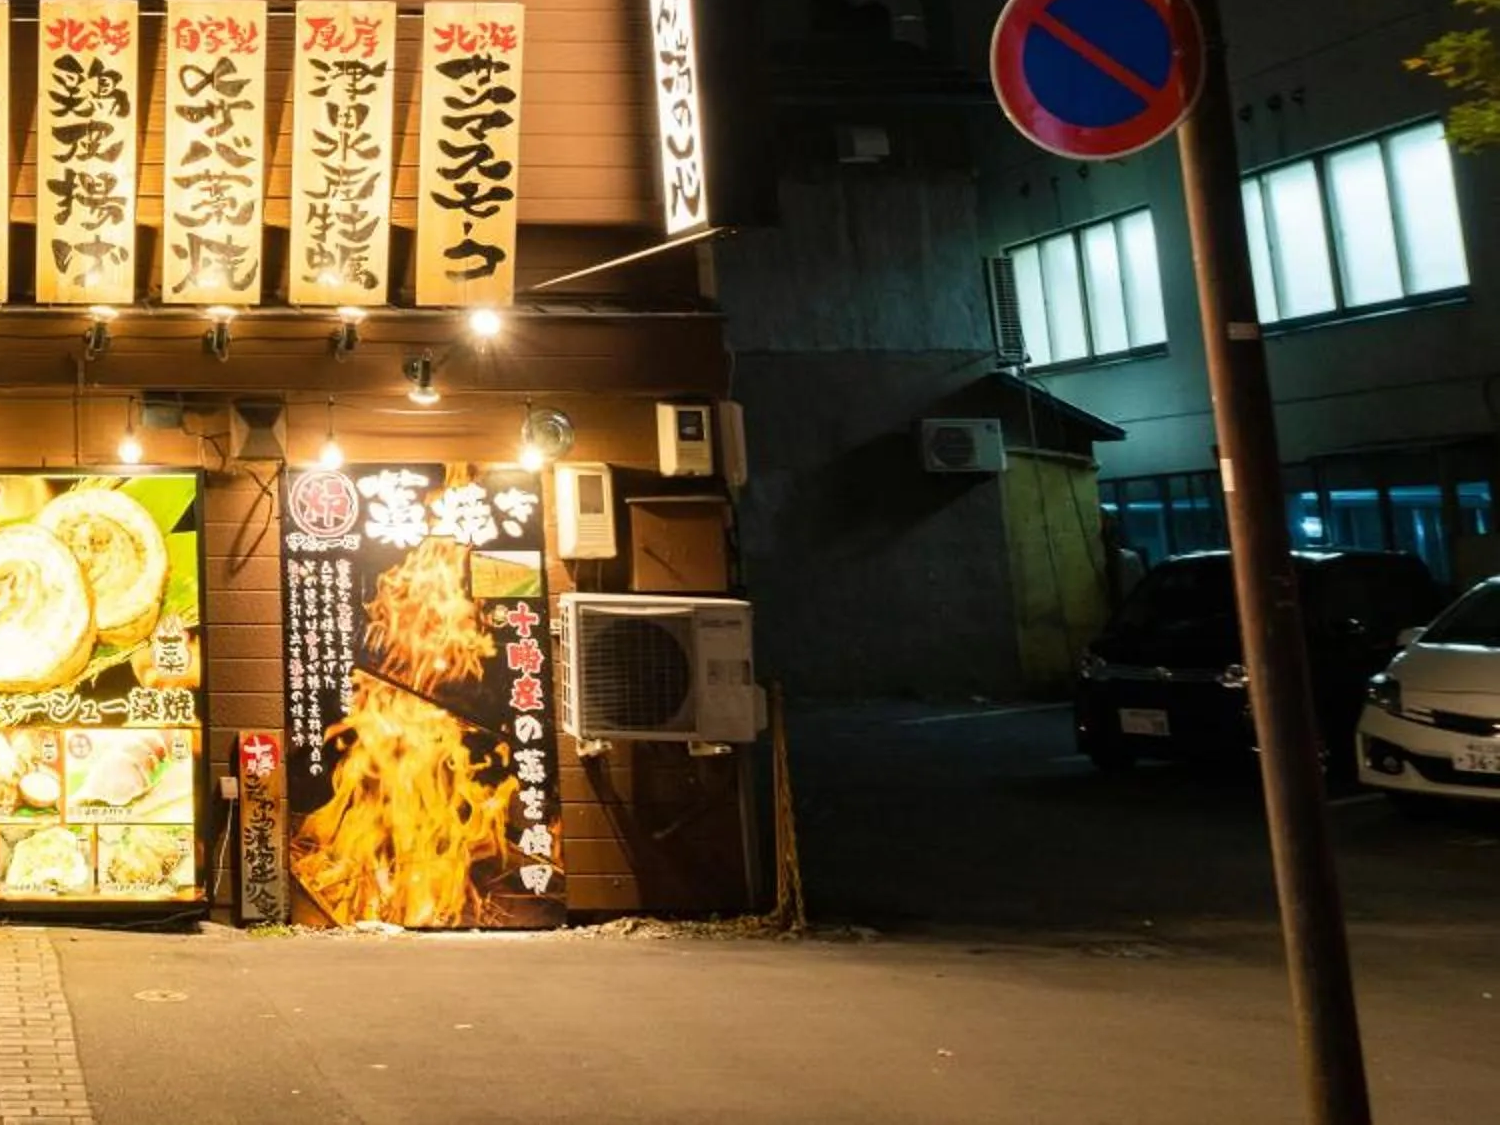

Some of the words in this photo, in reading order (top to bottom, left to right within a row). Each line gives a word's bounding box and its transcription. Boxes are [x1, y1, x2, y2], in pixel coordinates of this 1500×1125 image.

[431, 54, 517, 282] サンマスモーク
